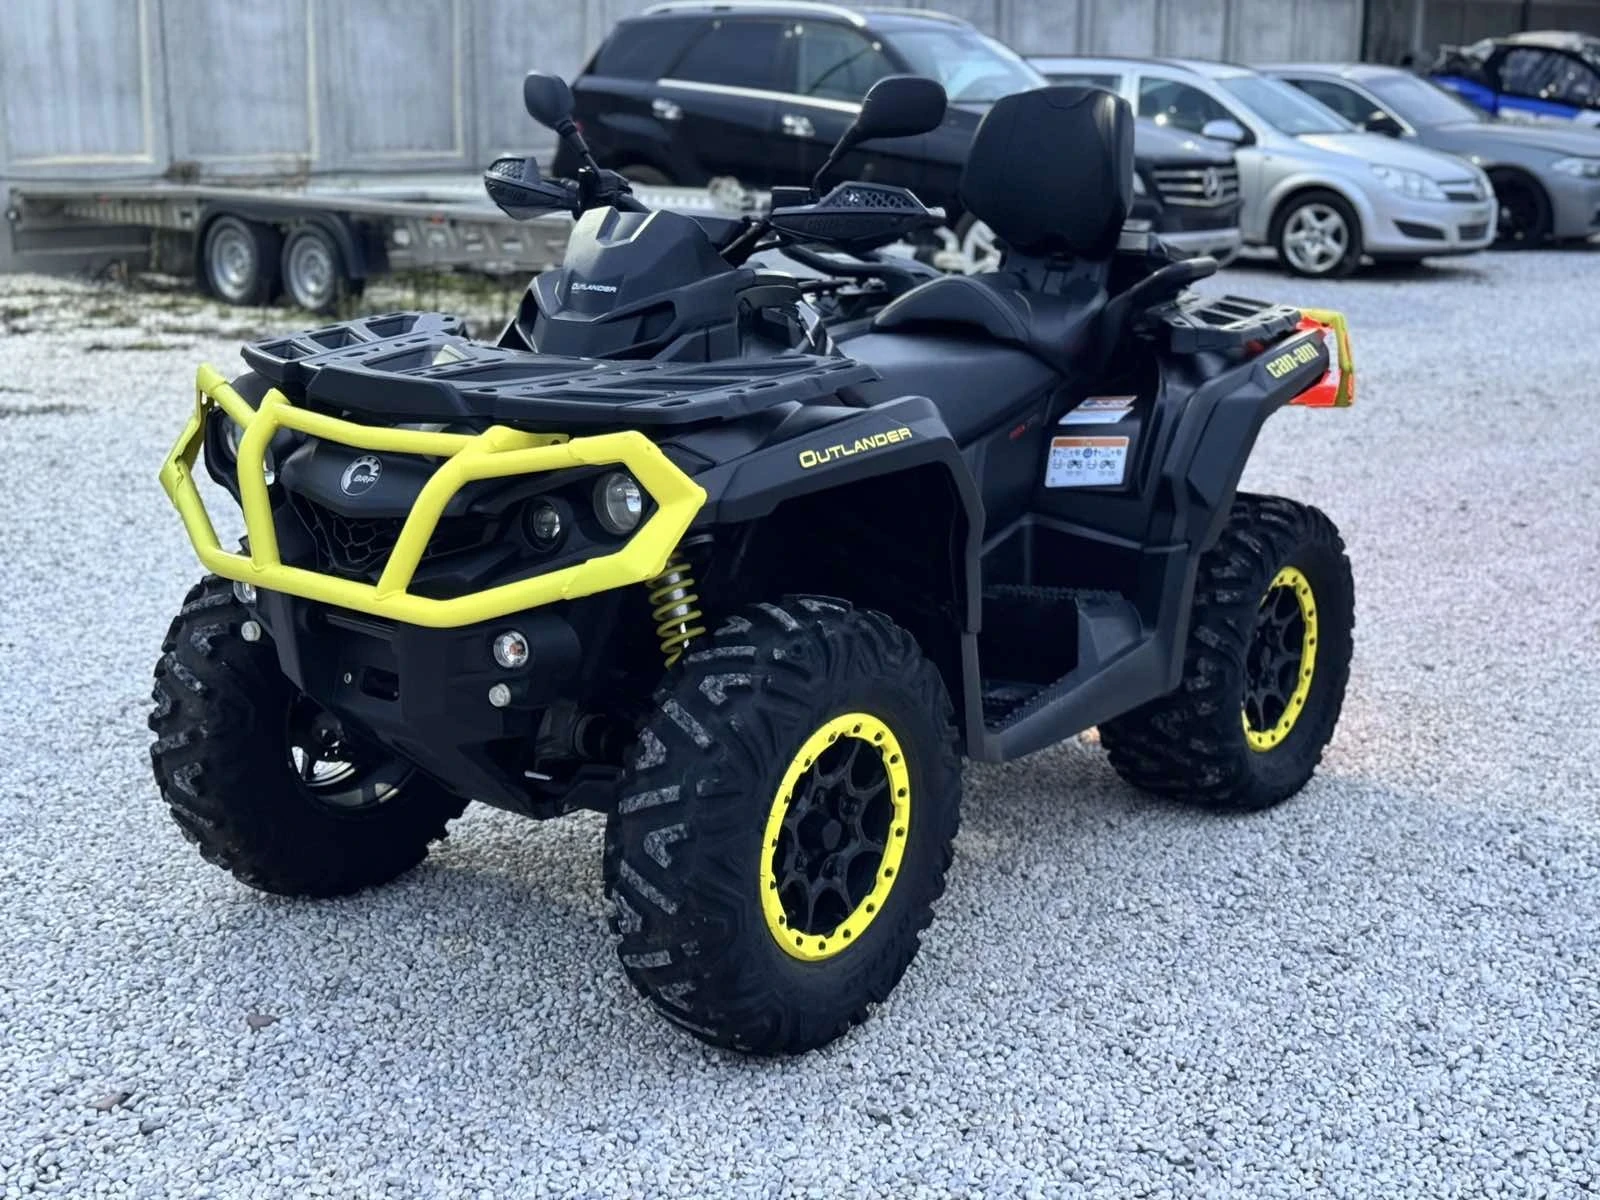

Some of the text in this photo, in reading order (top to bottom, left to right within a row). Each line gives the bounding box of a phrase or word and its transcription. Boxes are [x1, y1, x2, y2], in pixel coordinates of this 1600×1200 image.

[571, 282, 617, 293] OUTLANDER
[1265, 342, 1320, 379] can-am
[799, 427, 913, 469] OUTLANDER
[353, 474, 376, 484] BRP
